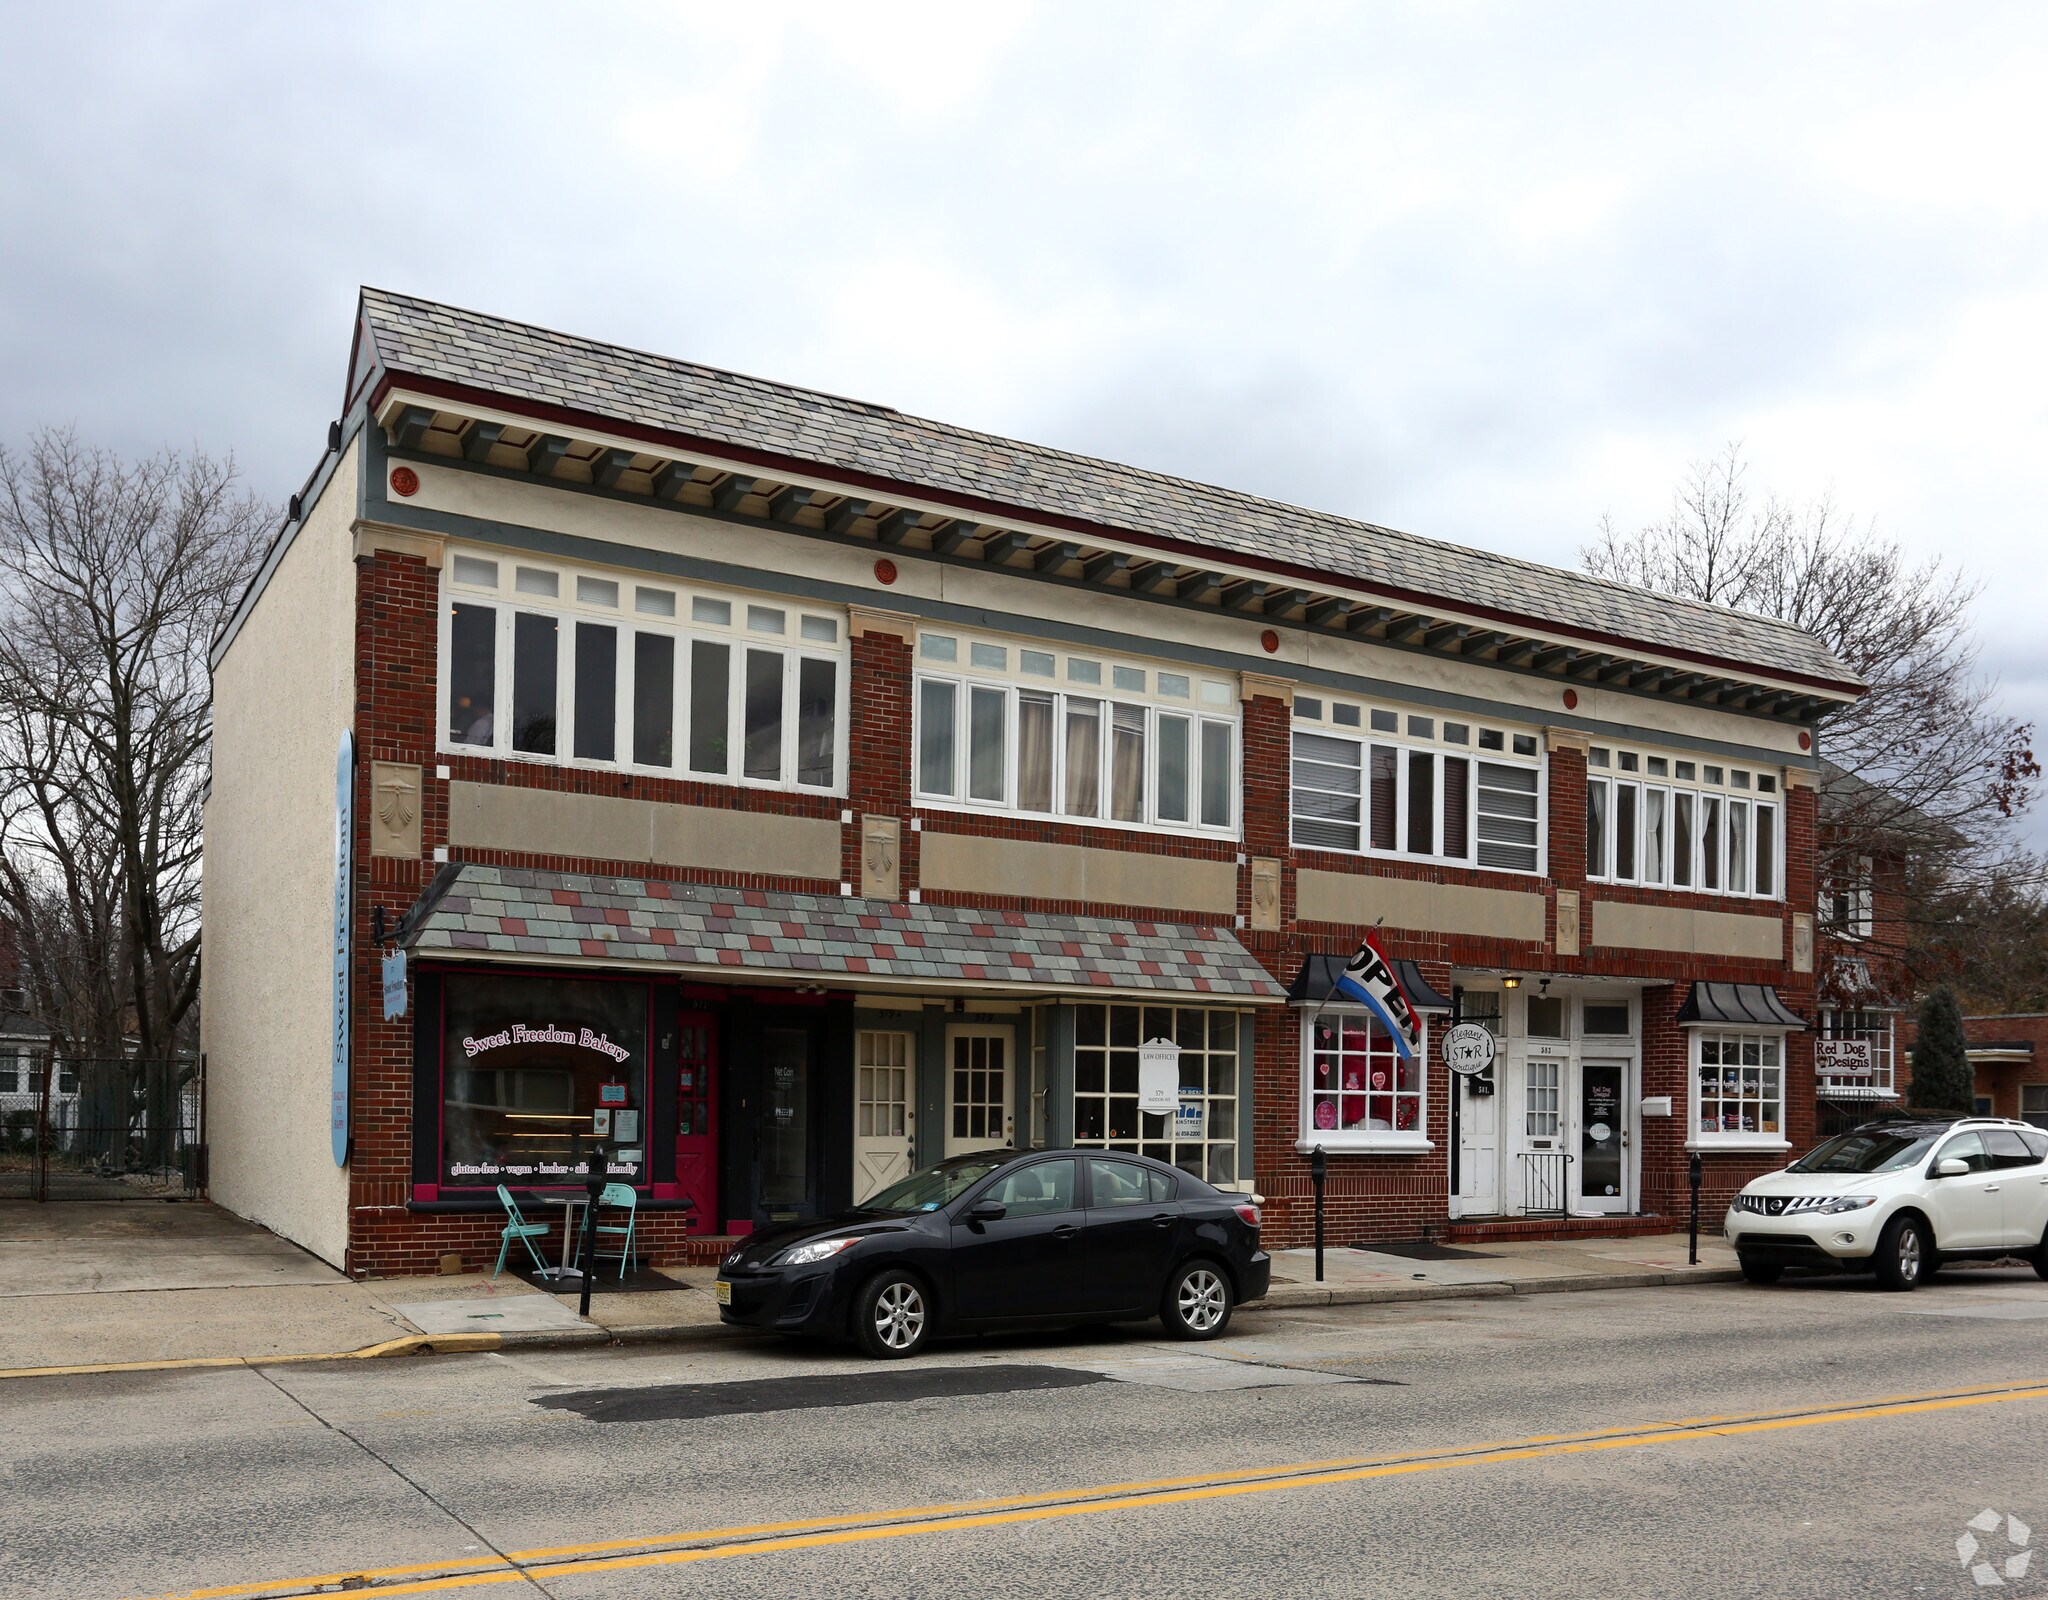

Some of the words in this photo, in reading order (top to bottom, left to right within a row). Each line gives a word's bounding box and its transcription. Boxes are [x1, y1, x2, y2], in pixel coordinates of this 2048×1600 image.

[338, 806, 348, 956] Freedom
[336, 964, 345, 1064] Sweet
[462, 1030, 511, 1057] Sweet
[512, 1024, 576, 1044] Freedom
[579, 1027, 631, 1062] Bakery
[1451, 1029, 1484, 1043] Elegant
[1154, 1053, 1176, 1061] OFFICES
[1816, 1041, 1837, 1054] Red
[1843, 1042, 1866, 1058] Dog
[1452, 1061, 1482, 1072] Boutique
[1827, 1055, 1870, 1070] Designs
[451, 1162, 499, 1176] gluten-free
[506, 1164, 532, 1176] vegan
[539, 1162, 568, 1174] kosher
